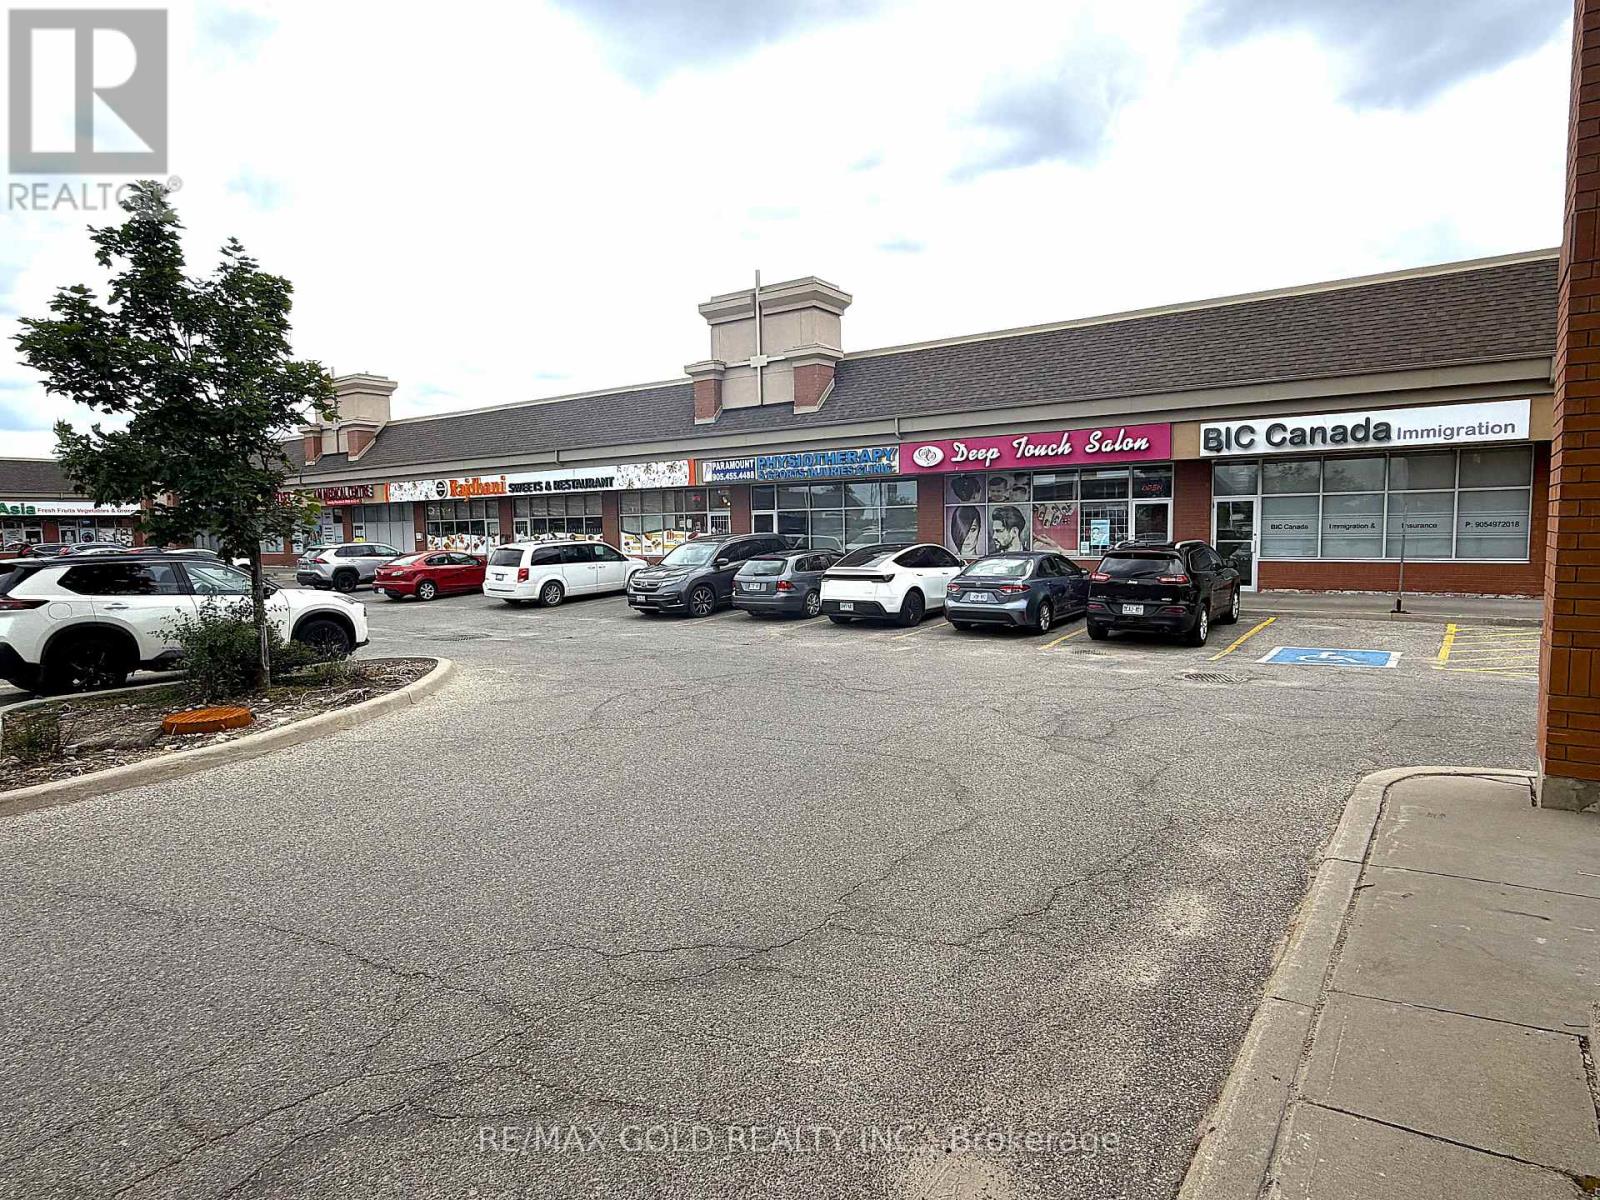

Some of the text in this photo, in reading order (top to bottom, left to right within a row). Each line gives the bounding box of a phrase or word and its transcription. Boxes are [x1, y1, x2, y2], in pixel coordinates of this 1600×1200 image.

[1203, 417, 1516, 453] BIC Canada Immigration
[951, 428, 1149, 467] Deep Touch Salon
[712, 459, 754, 471] PARAMOUNT
[757, 447, 898, 470] PHYSIOTHERAPY
[767, 468, 806, 479] SPORTS
[807, 465, 853, 477] INJURIES
[856, 463, 894, 475] CLINIC
[449, 475, 615, 502] Rajdhani SWEETS & RESTAURANT
[0, 502, 36, 515] Asia
[1329, 523, 1369, 531] Immigration
[1475, 520, 1520, 528] 9054972018
